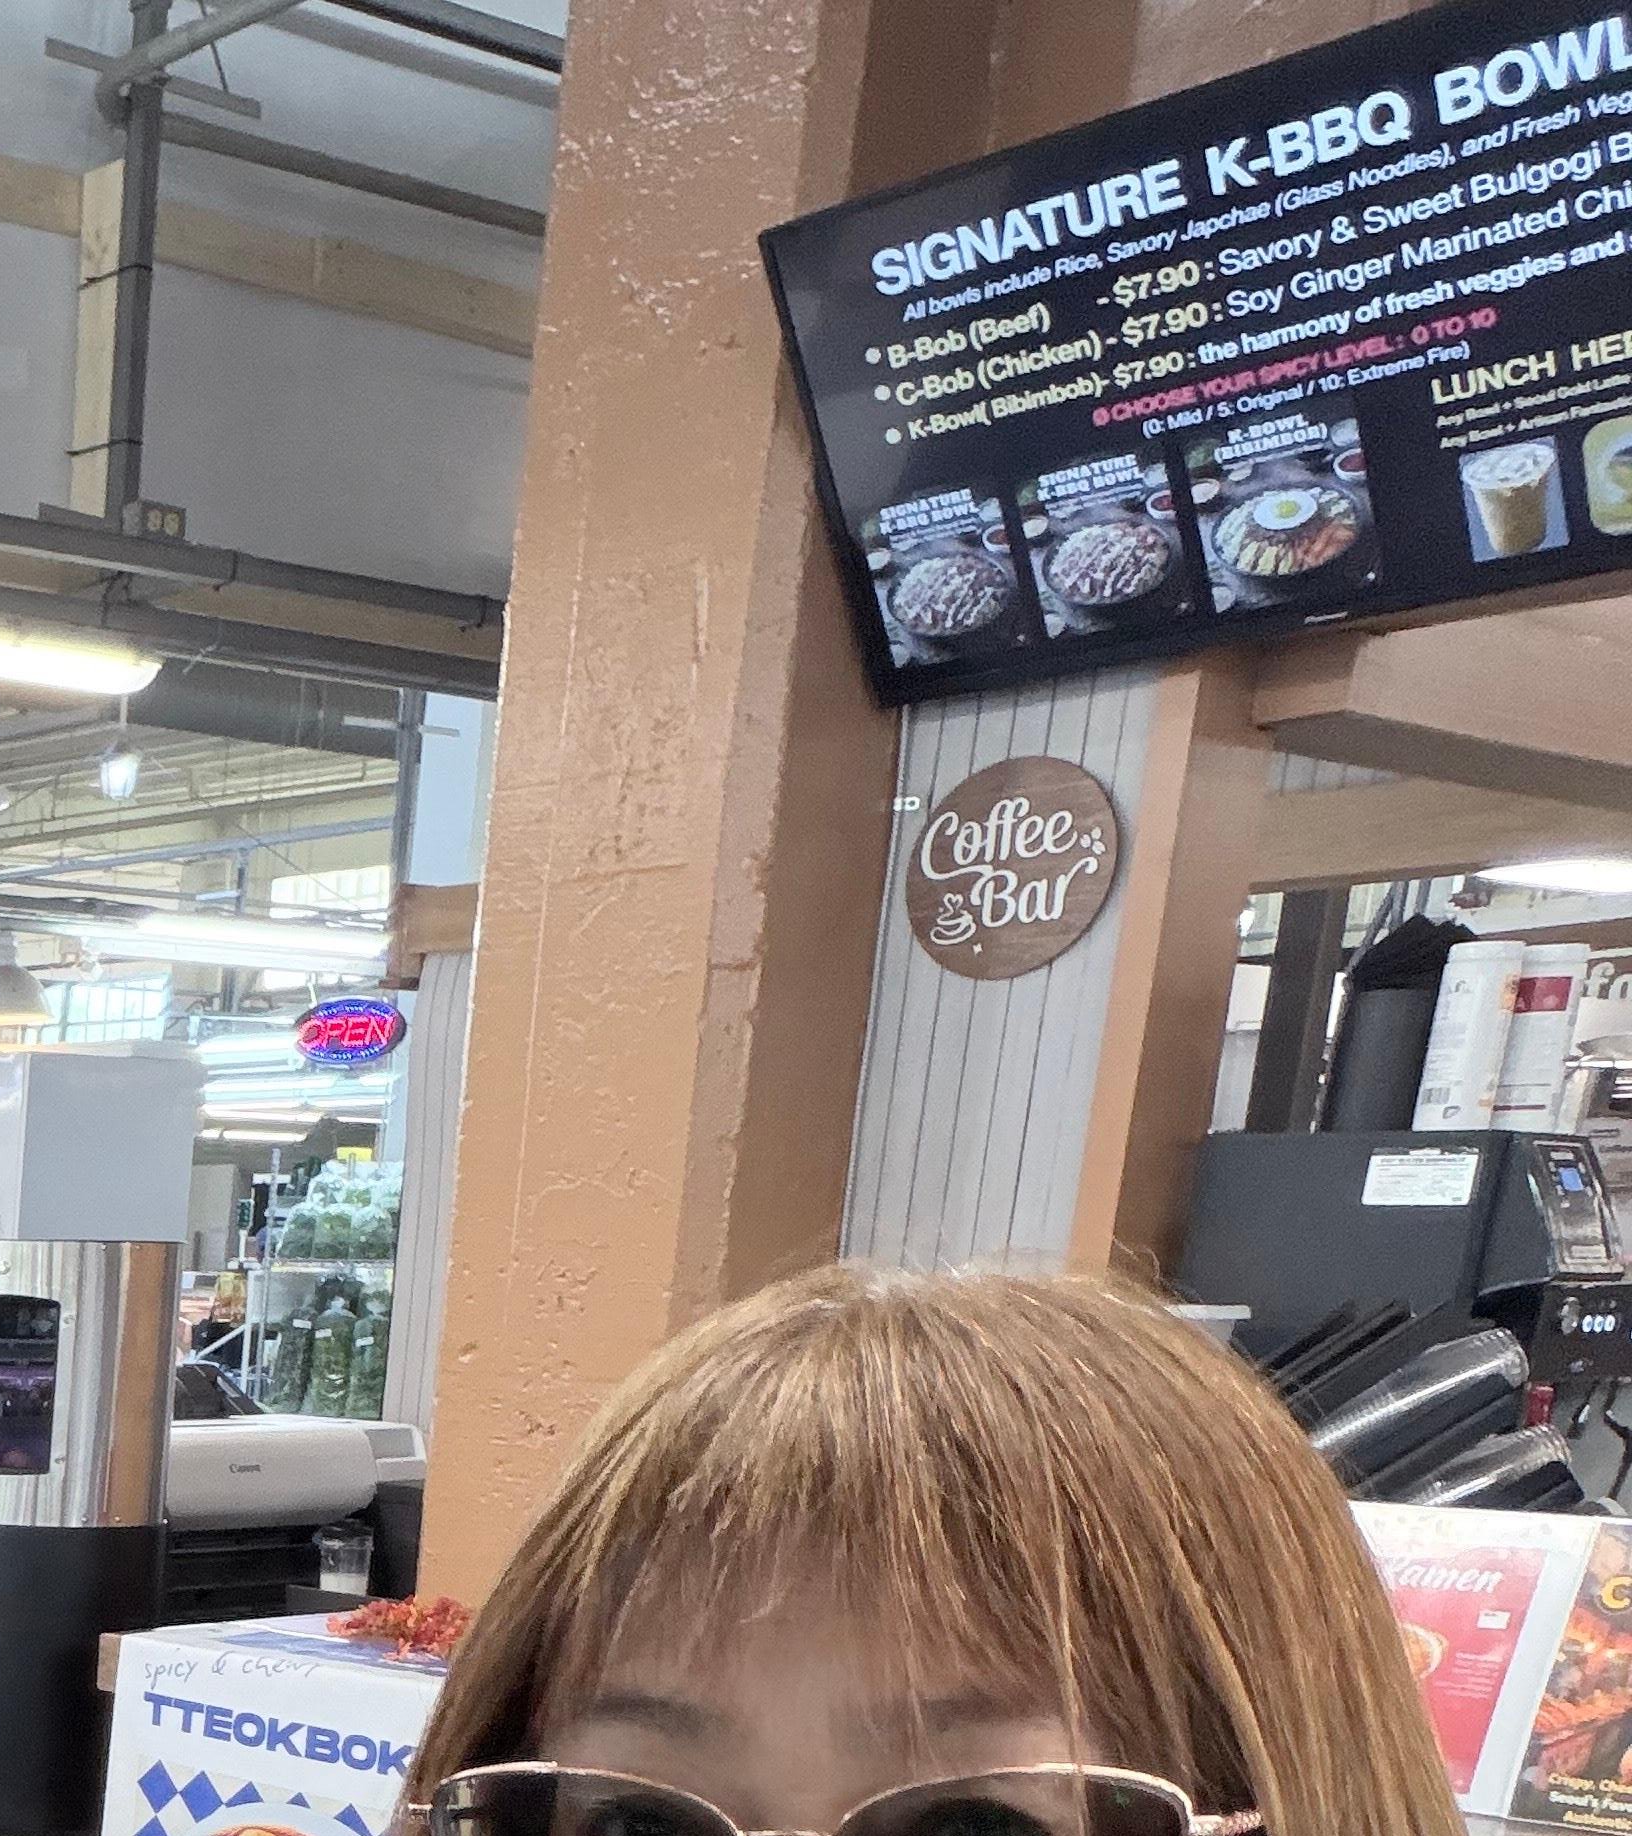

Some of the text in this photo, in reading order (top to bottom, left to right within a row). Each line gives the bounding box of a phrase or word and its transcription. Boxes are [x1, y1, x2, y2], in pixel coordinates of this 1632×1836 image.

[870, 158, 1188, 296] SIGNATURE
[1204, 90, 1413, 196] K-BBQ
[902, 299, 927, 323] All
[928, 286, 982, 316] bowls
[984, 265, 1052, 300] include
[1054, 252, 1104, 279] Rice,
[1106, 227, 1178, 263] Savory
[1181, 200, 1271, 242] Japchae
[1274, 180, 1344, 217] (Glass
[1348, 141, 1457, 192] Noodles),
[1461, 123, 1509, 159] and
[1510, 104, 1581, 143] Fresh
[886, 328, 968, 370] B-Bob
[969, 301, 1052, 352] (Beef)
[1112, 259, 1201, 309] $7.90
[1217, 227, 1323, 277] Savory
[1329, 215, 1360, 246] &
[1362, 184, 1466, 236] Sweet
[1469, 140, 1603, 204] Bulgogi
[895, 366, 975, 407] C-Bob
[976, 328, 1103, 390] (Chicken)
[1120, 301, 1209, 348] $7.90
[1225, 284, 1285, 318] Soy
[1289, 250, 1395, 302] Ginger
[1399, 197, 1570, 271] Marinated
[1112, 350, 1185, 390] $7.90
[1197, 340, 1239, 365] the
[1239, 309, 1351, 354] harmony
[1354, 295, 1383, 324] of
[1385, 279, 1456, 316] fresh
[1459, 251, 1567, 296] veggies
[1569, 229, 1626, 266] and
[1431, 315, 1466, 339] TO
[1236, 382, 1305, 413] Original
[1346, 353, 1426, 386] Extreme
[1426, 339, 1471, 366] Fire)
[1430, 349, 1558, 405] LUNCH
[920, 796, 1081, 880] Coffee
[970, 857, 1099, 929] Bar
[296, 1015, 396, 1051] OPEN
[143, 1658, 199, 1691] spicy
[143, 1689, 426, 1779] TTEOKBOK
